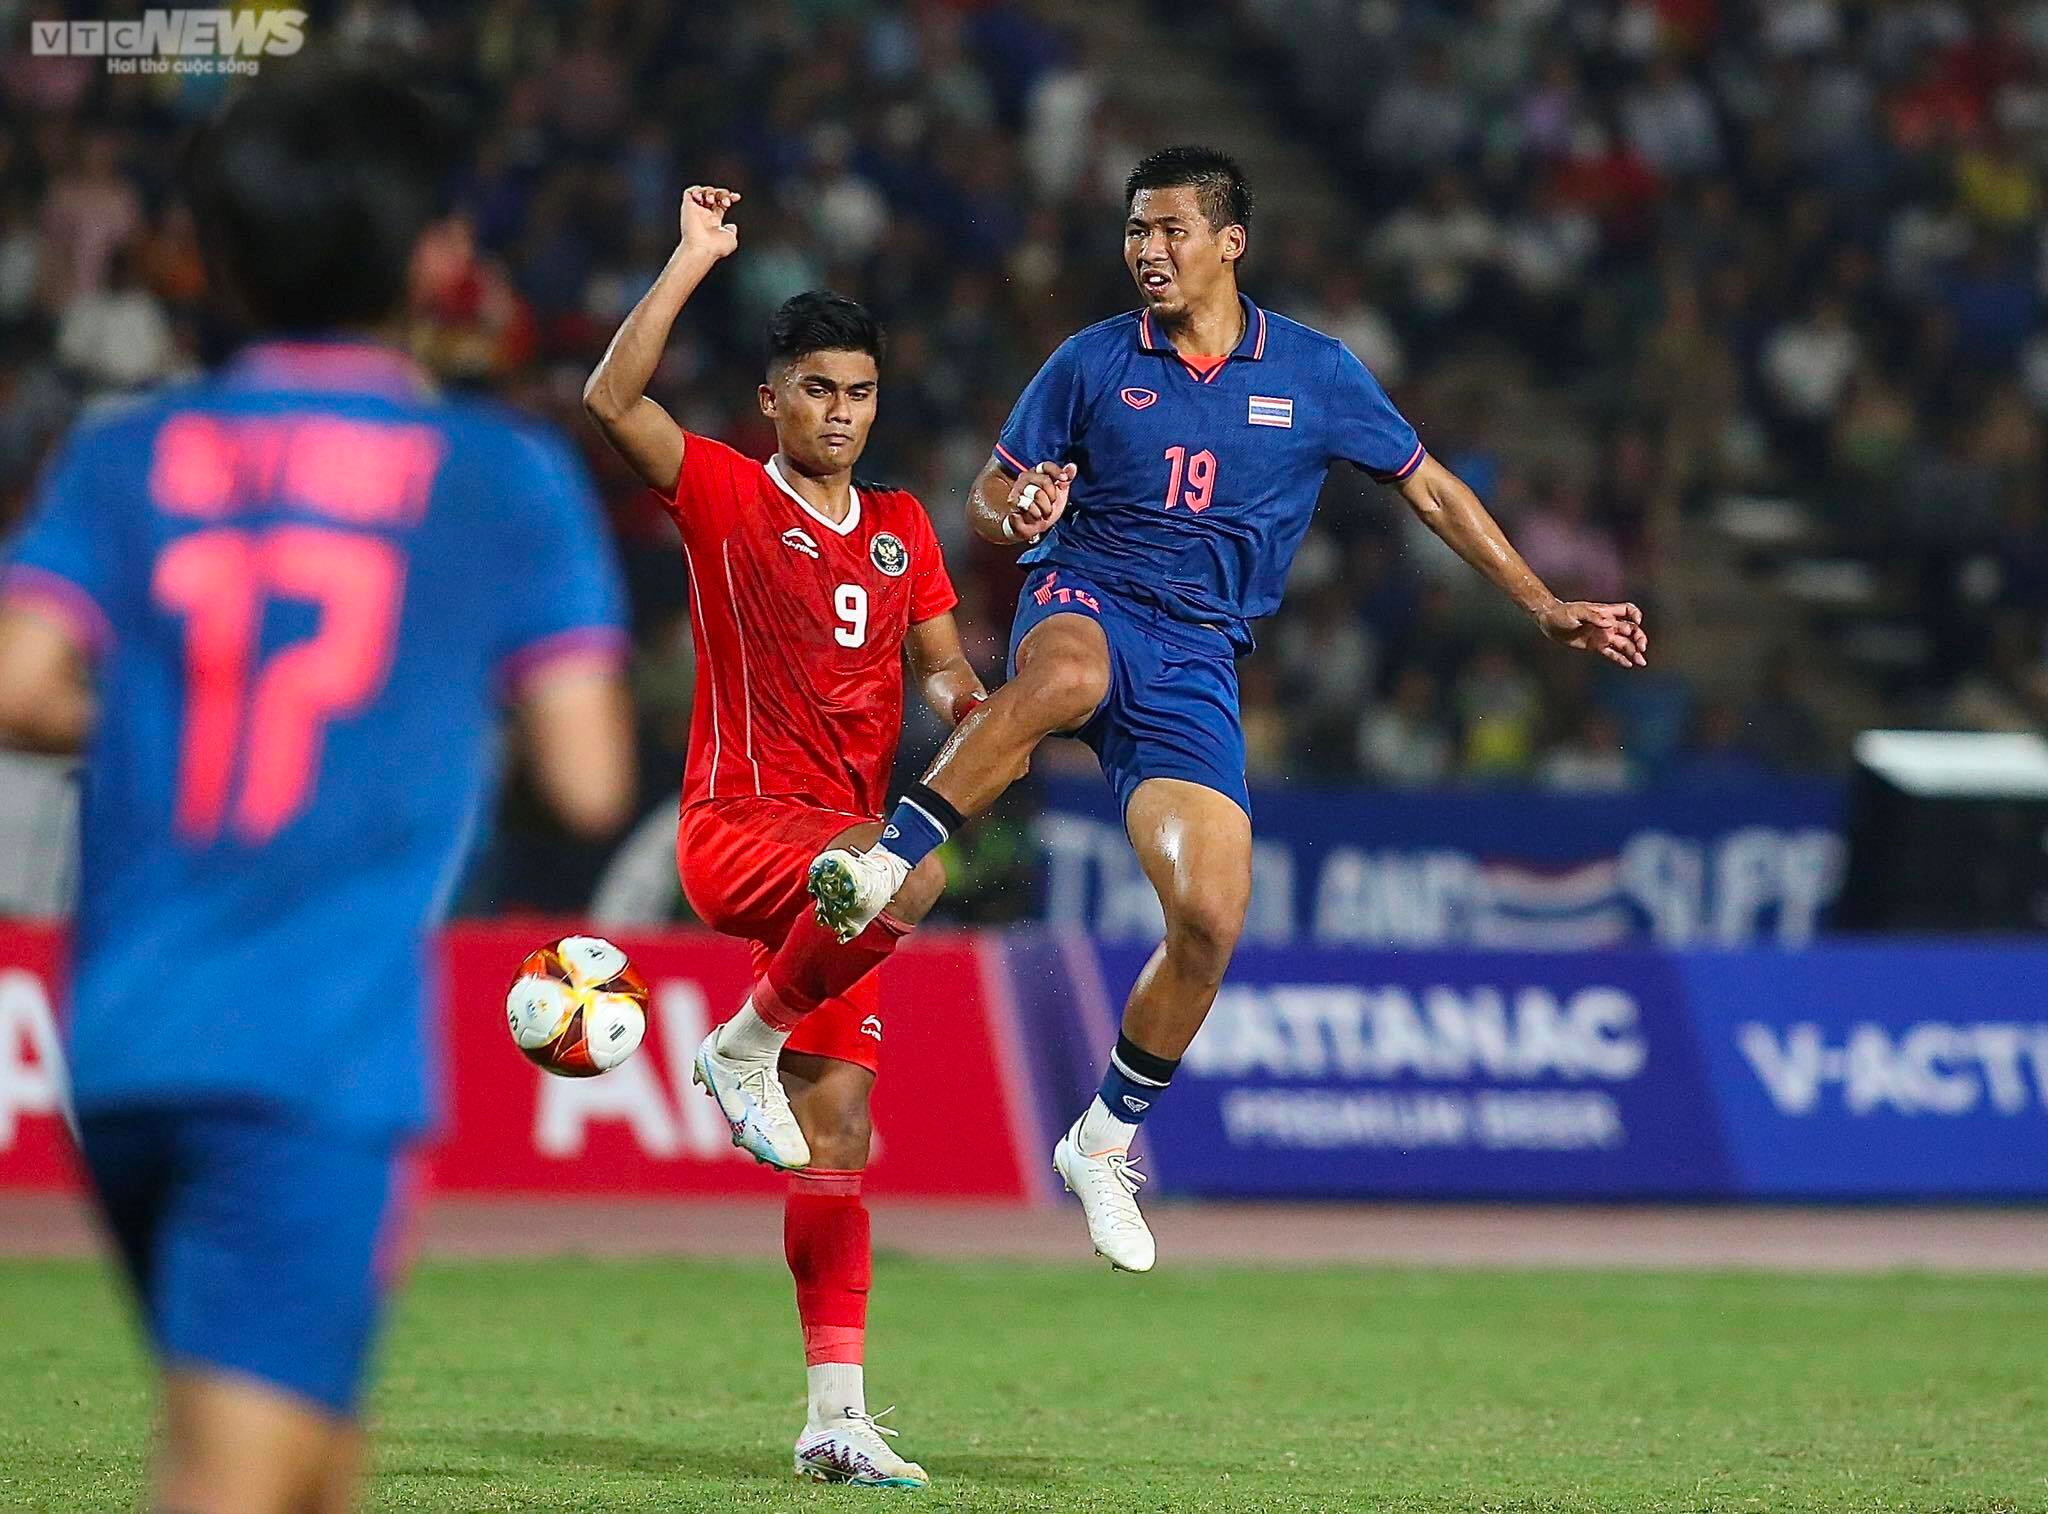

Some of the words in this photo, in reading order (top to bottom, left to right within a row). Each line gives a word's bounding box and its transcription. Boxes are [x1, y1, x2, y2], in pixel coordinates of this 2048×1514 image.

[1164, 446, 1217, 514] 19
[834, 583, 868, 649] 9
[152, 525, 408, 850] 17
[1184, 985, 1648, 1079] ATTANAC
